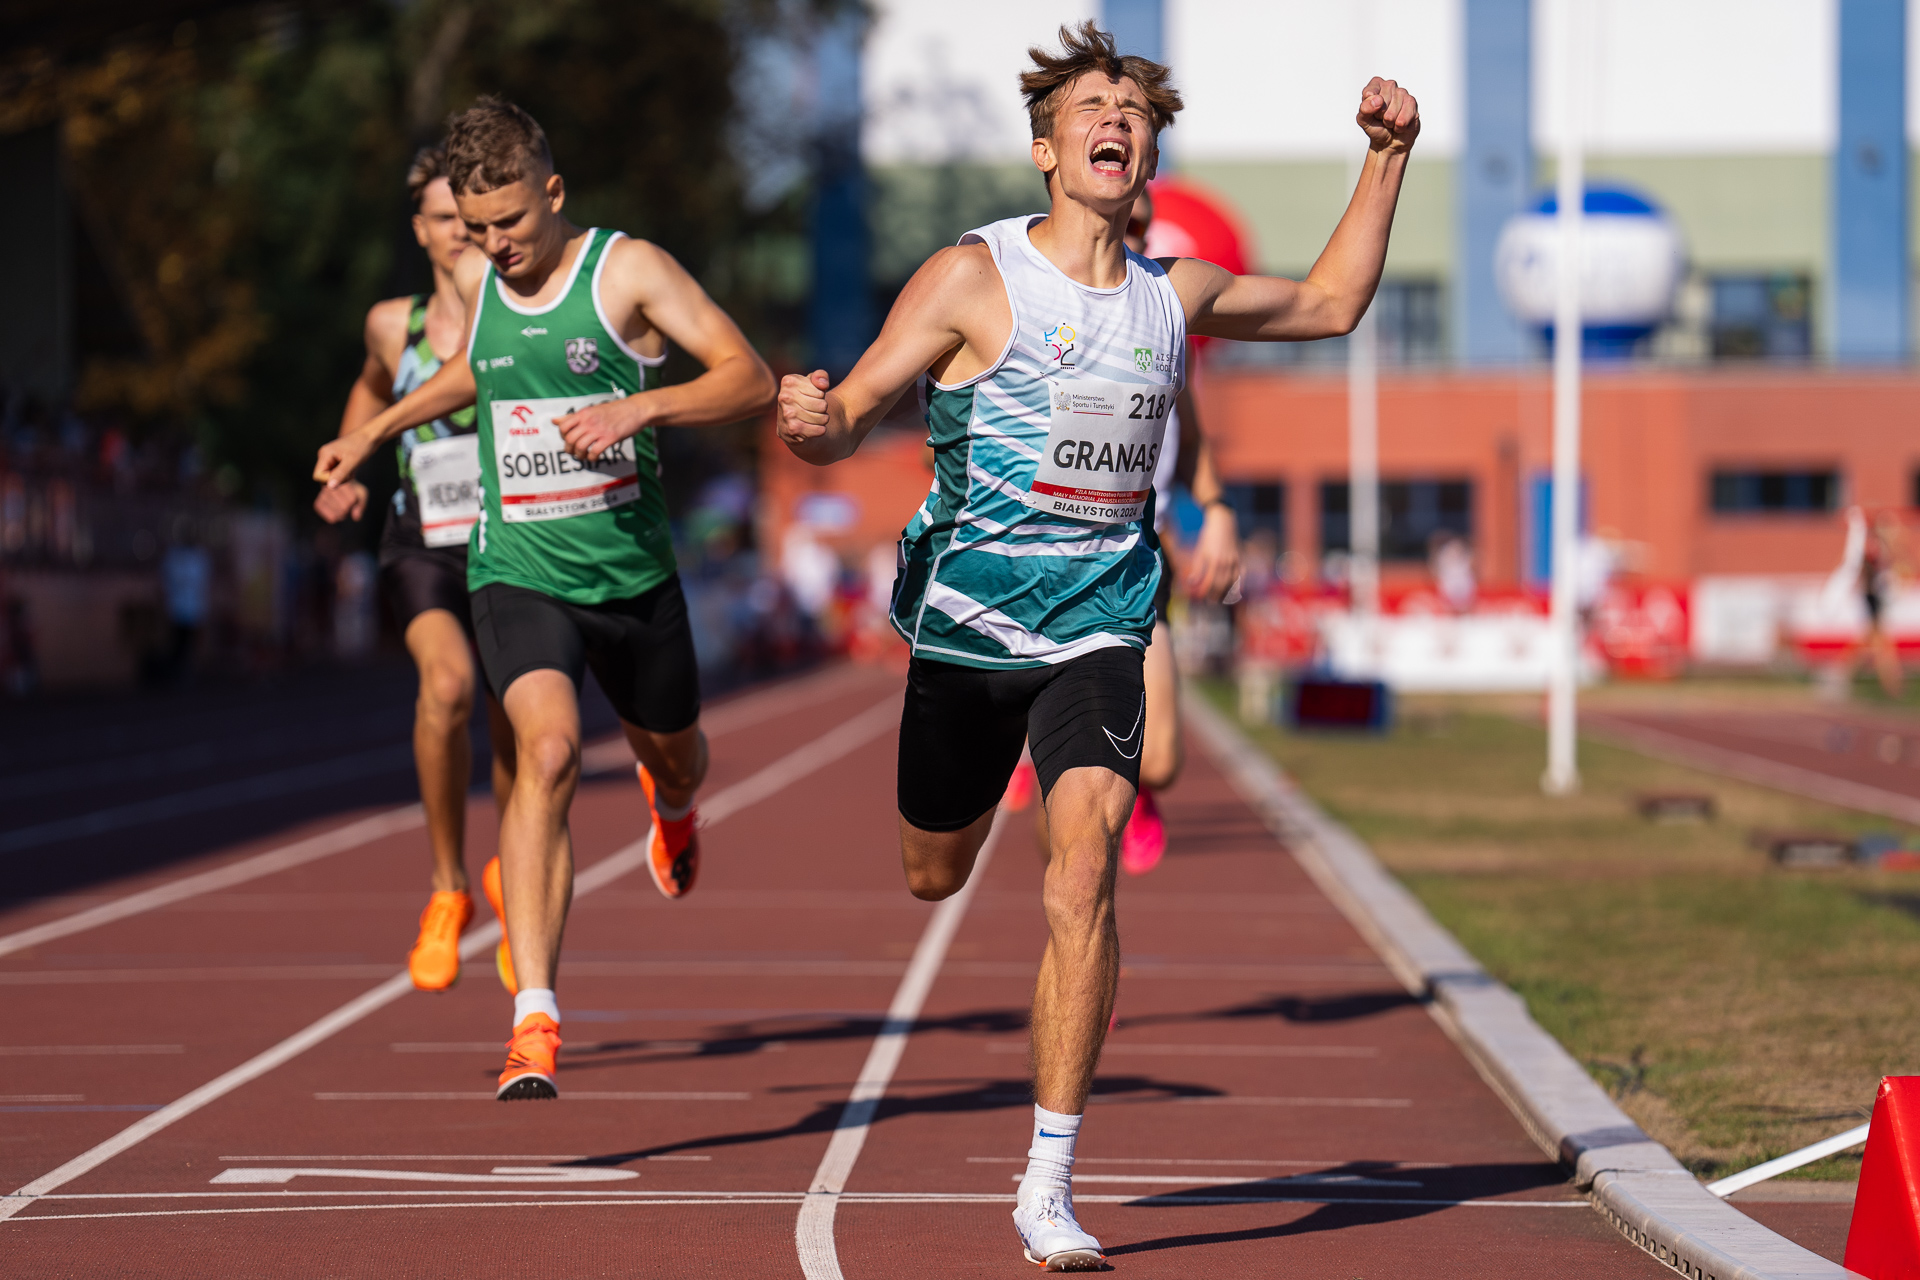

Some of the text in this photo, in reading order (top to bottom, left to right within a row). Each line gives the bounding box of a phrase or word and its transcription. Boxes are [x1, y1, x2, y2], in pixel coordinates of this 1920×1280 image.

[1072, 394, 1105, 402] Ministerstwo
[1072, 401, 1089, 409] Sportu
[1093, 403, 1115, 411] Turystyki
[1128, 393, 1166, 419] 218
[1053, 439, 1157, 473] GRANAS
[1053, 501, 1138, 518] BIAŁYSTOK 2024
